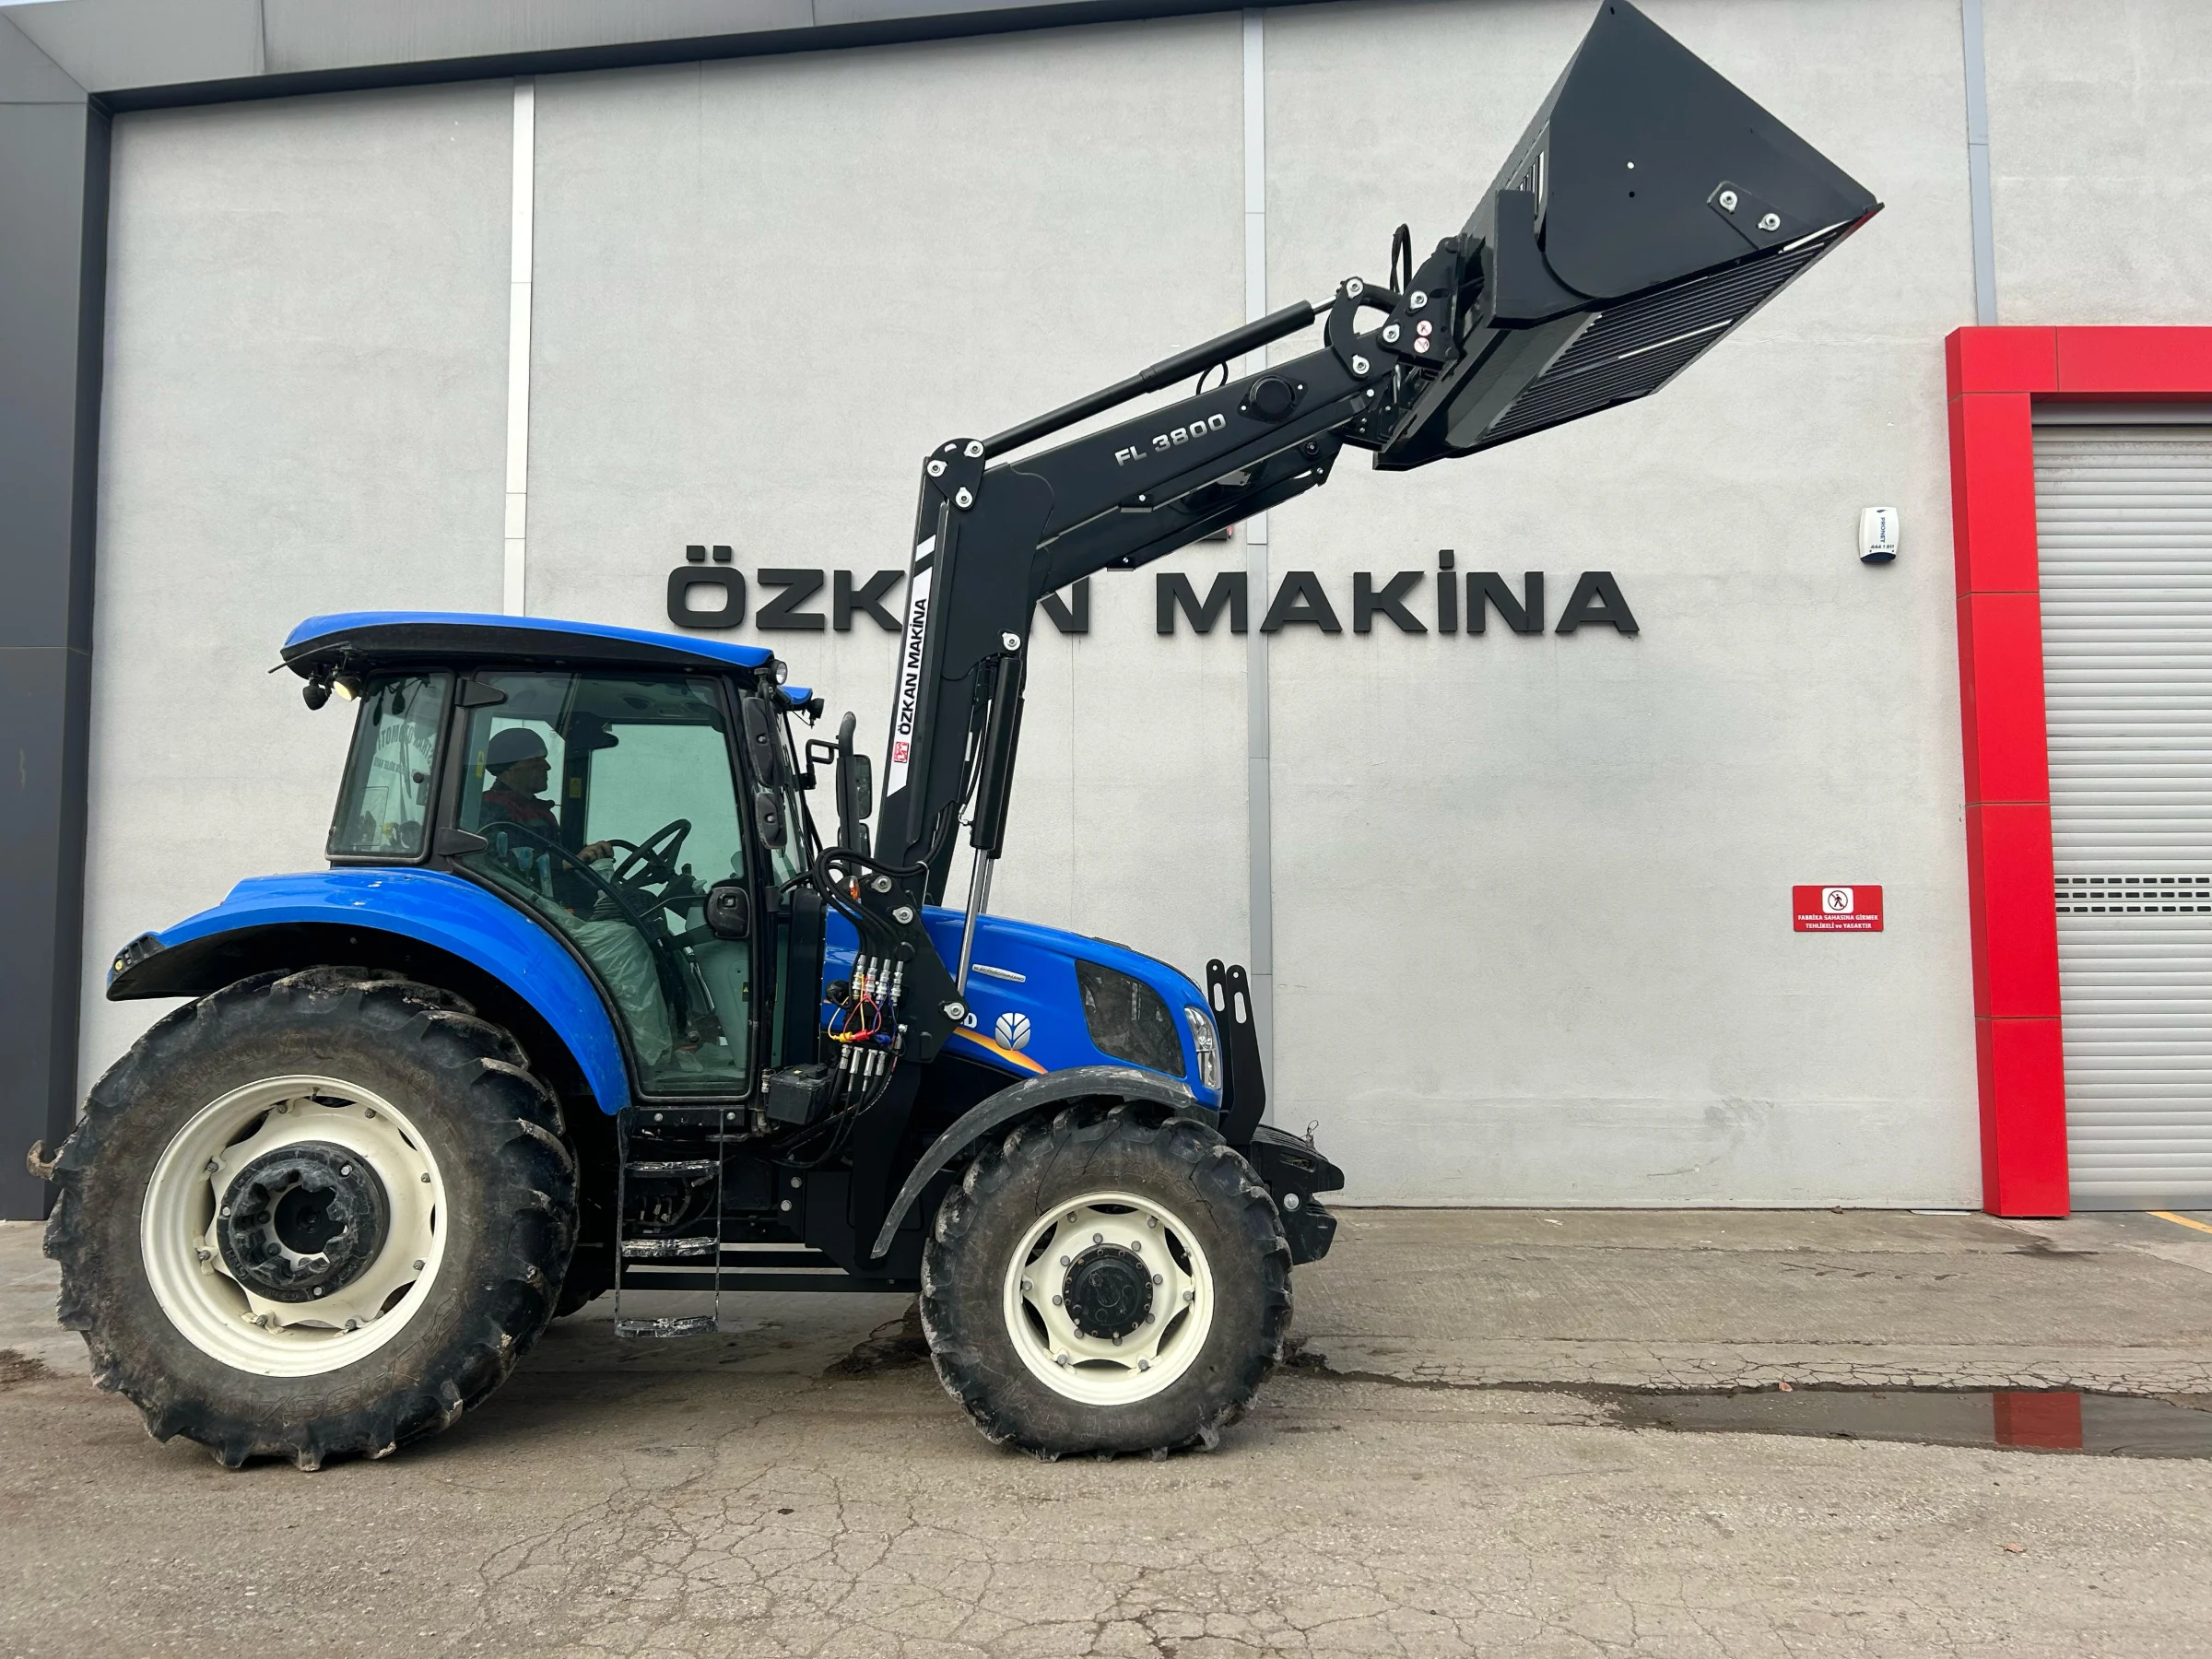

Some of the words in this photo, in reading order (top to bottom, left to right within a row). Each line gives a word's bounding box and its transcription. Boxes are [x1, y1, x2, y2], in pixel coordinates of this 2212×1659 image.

[1114, 444, 1147, 467] FL
[1152, 413, 1227, 453] 3800
[667, 545, 1089, 635] ÖZKN
[1156, 549, 1641, 635] MAKİNA
[897, 673, 918, 735] ÖZKAN
[908, 598, 927, 669] MAKİNA
